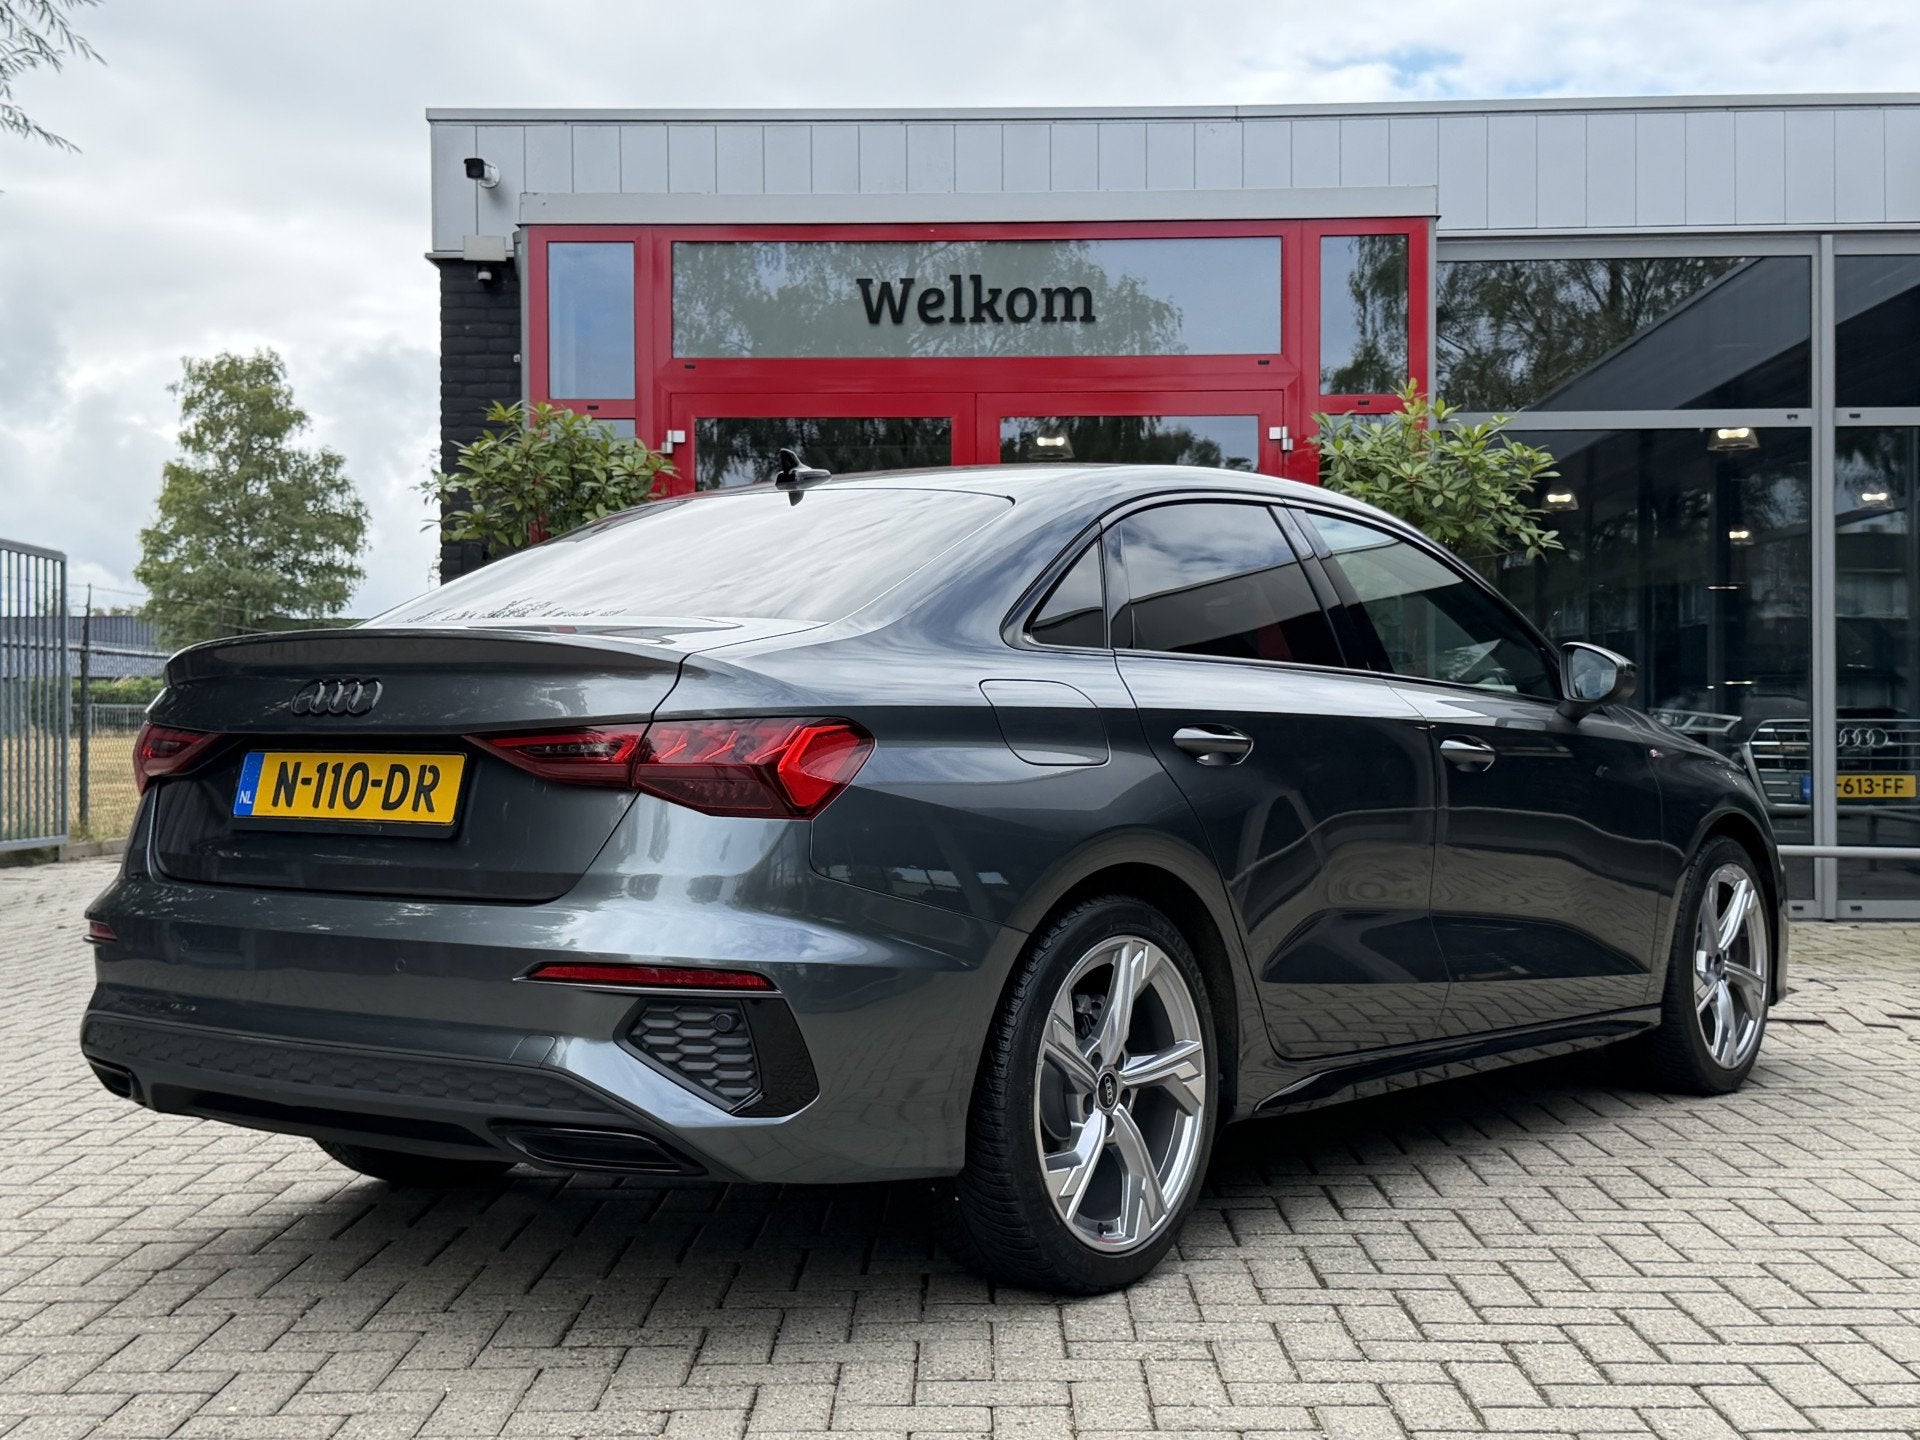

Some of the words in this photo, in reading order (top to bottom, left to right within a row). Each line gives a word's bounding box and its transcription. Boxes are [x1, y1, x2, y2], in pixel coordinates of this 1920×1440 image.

[856, 274, 1096, 324] Welkom
[239, 790, 253, 804] NL
[271, 761, 440, 812] N-110-DR
[1836, 778, 1905, 794] -613-FF
